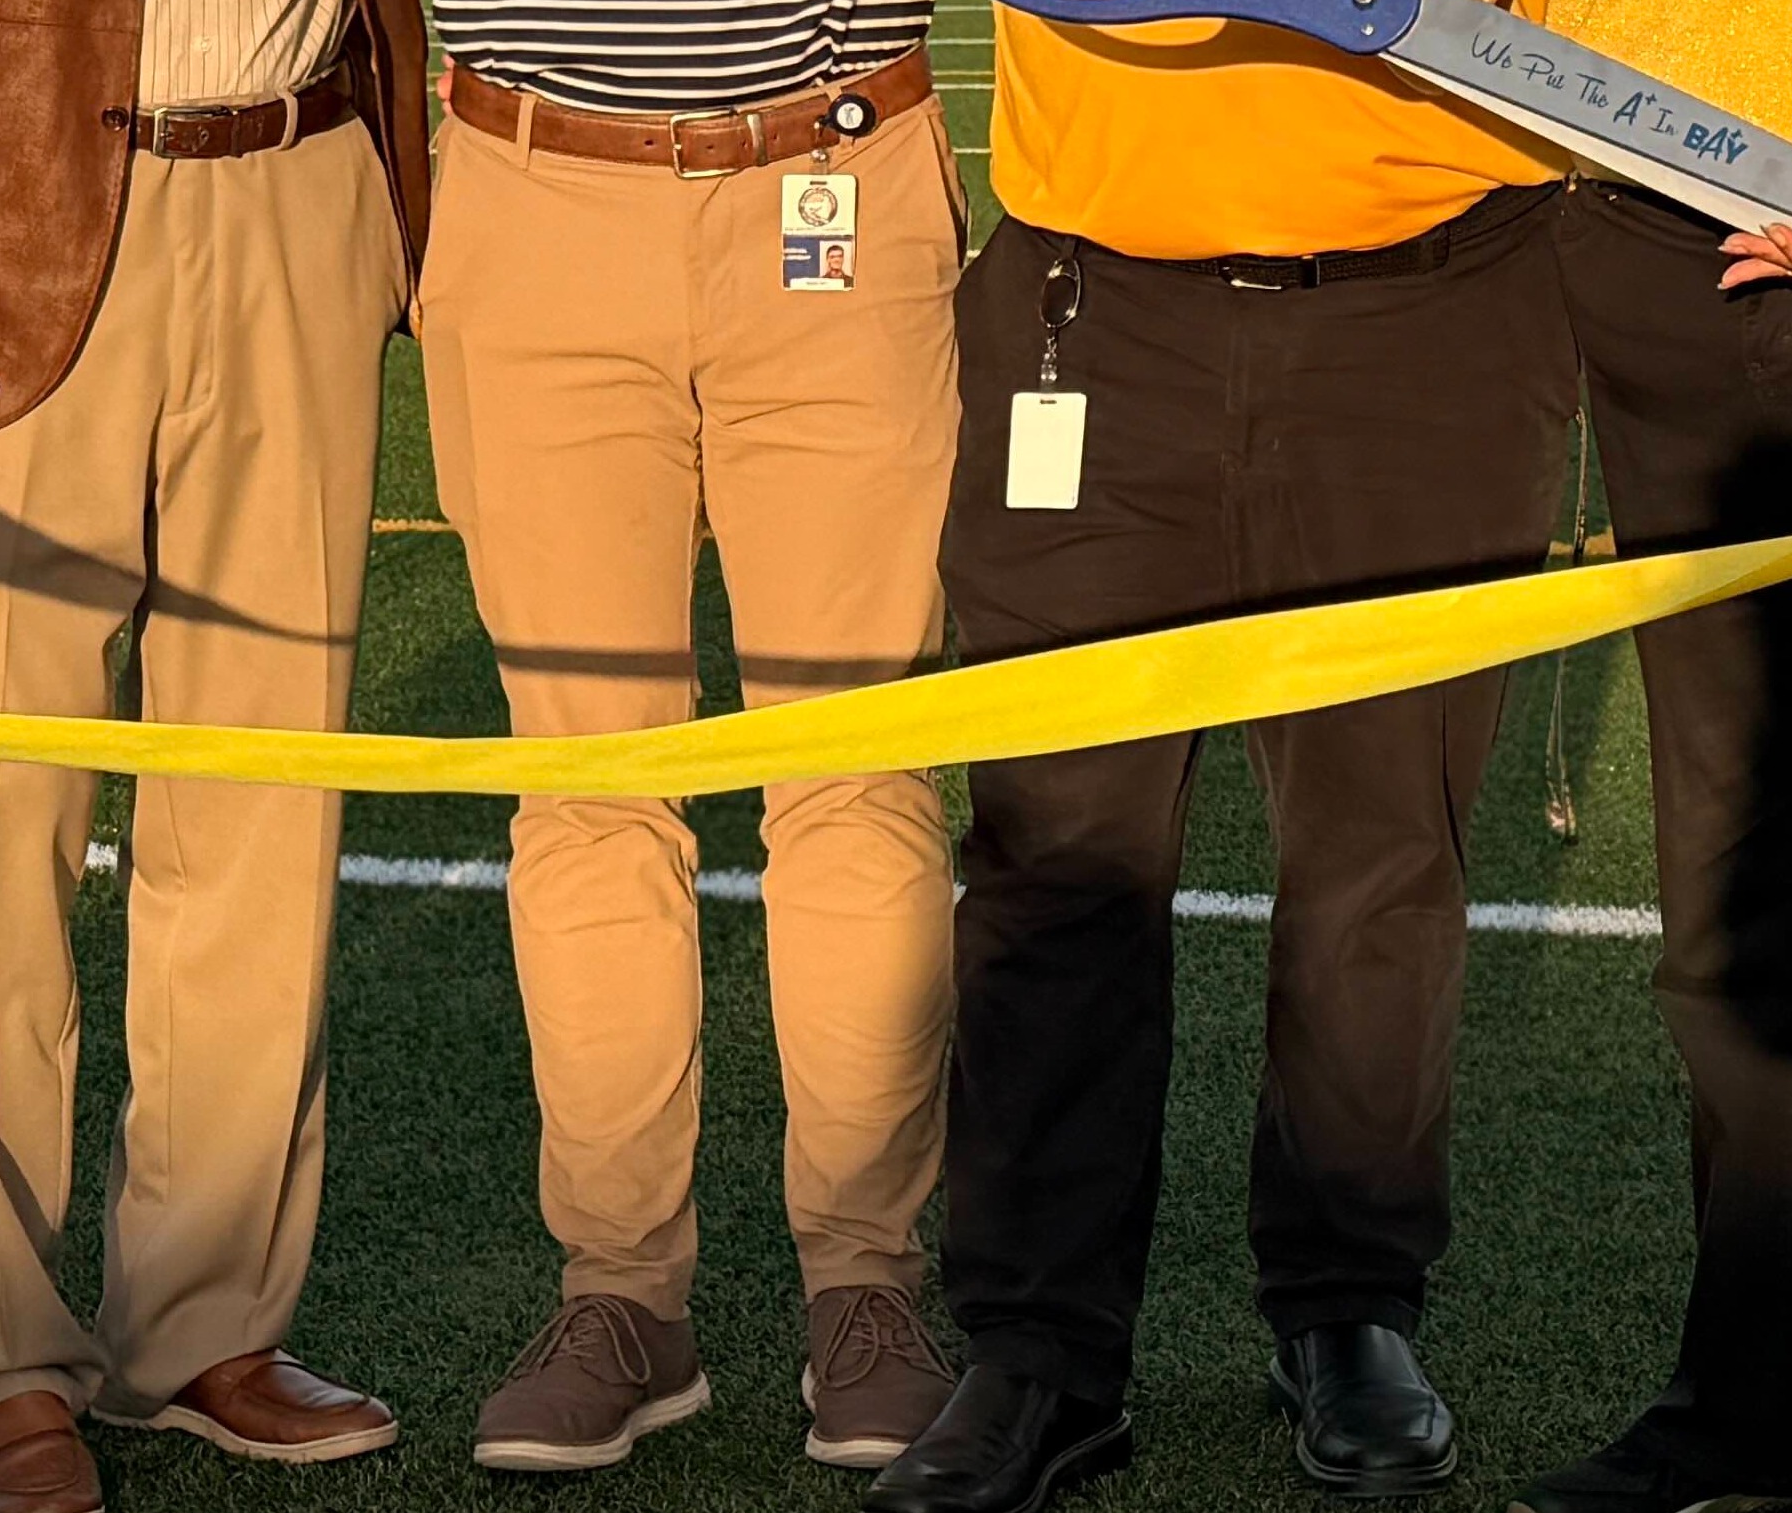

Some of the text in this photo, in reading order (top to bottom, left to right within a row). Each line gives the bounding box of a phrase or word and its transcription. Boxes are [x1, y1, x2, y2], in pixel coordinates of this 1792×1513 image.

[1519, 53, 1565, 90] Put
[1576, 72, 1609, 108] The
[1648, 108, 1677, 137] In
